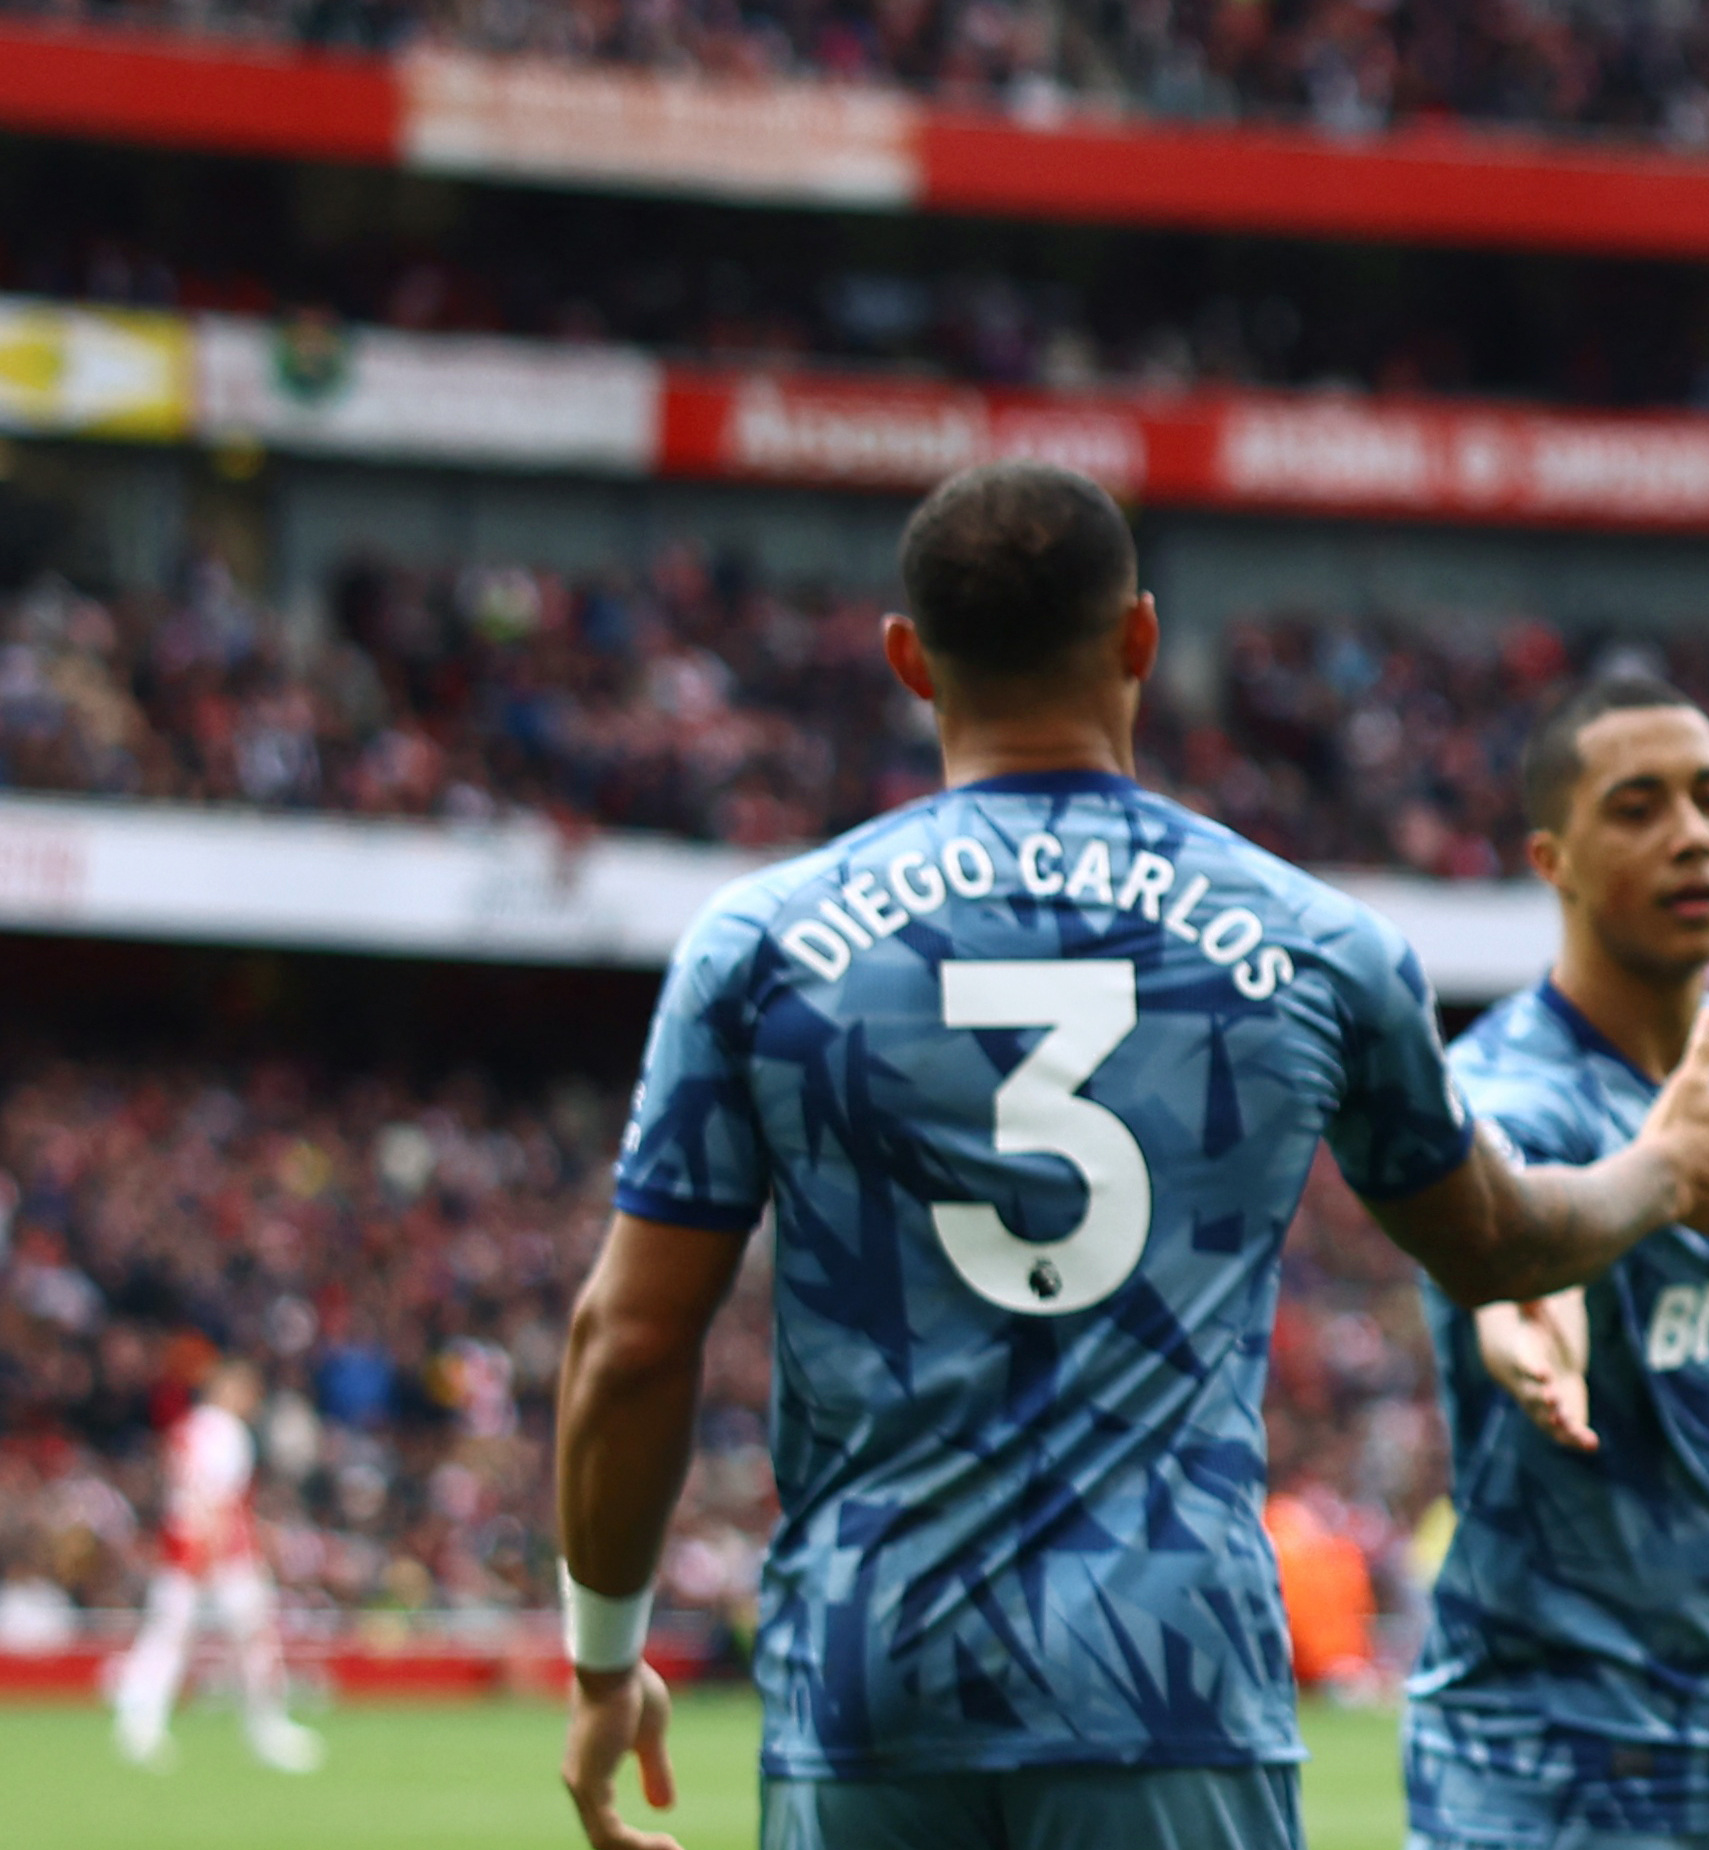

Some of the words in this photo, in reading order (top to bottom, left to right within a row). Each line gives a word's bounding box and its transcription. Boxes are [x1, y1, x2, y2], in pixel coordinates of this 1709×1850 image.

[781, 836, 996, 982] DIEGO
[1019, 832, 1295, 1001] CARLOS
[931, 958, 1152, 1316] 3
